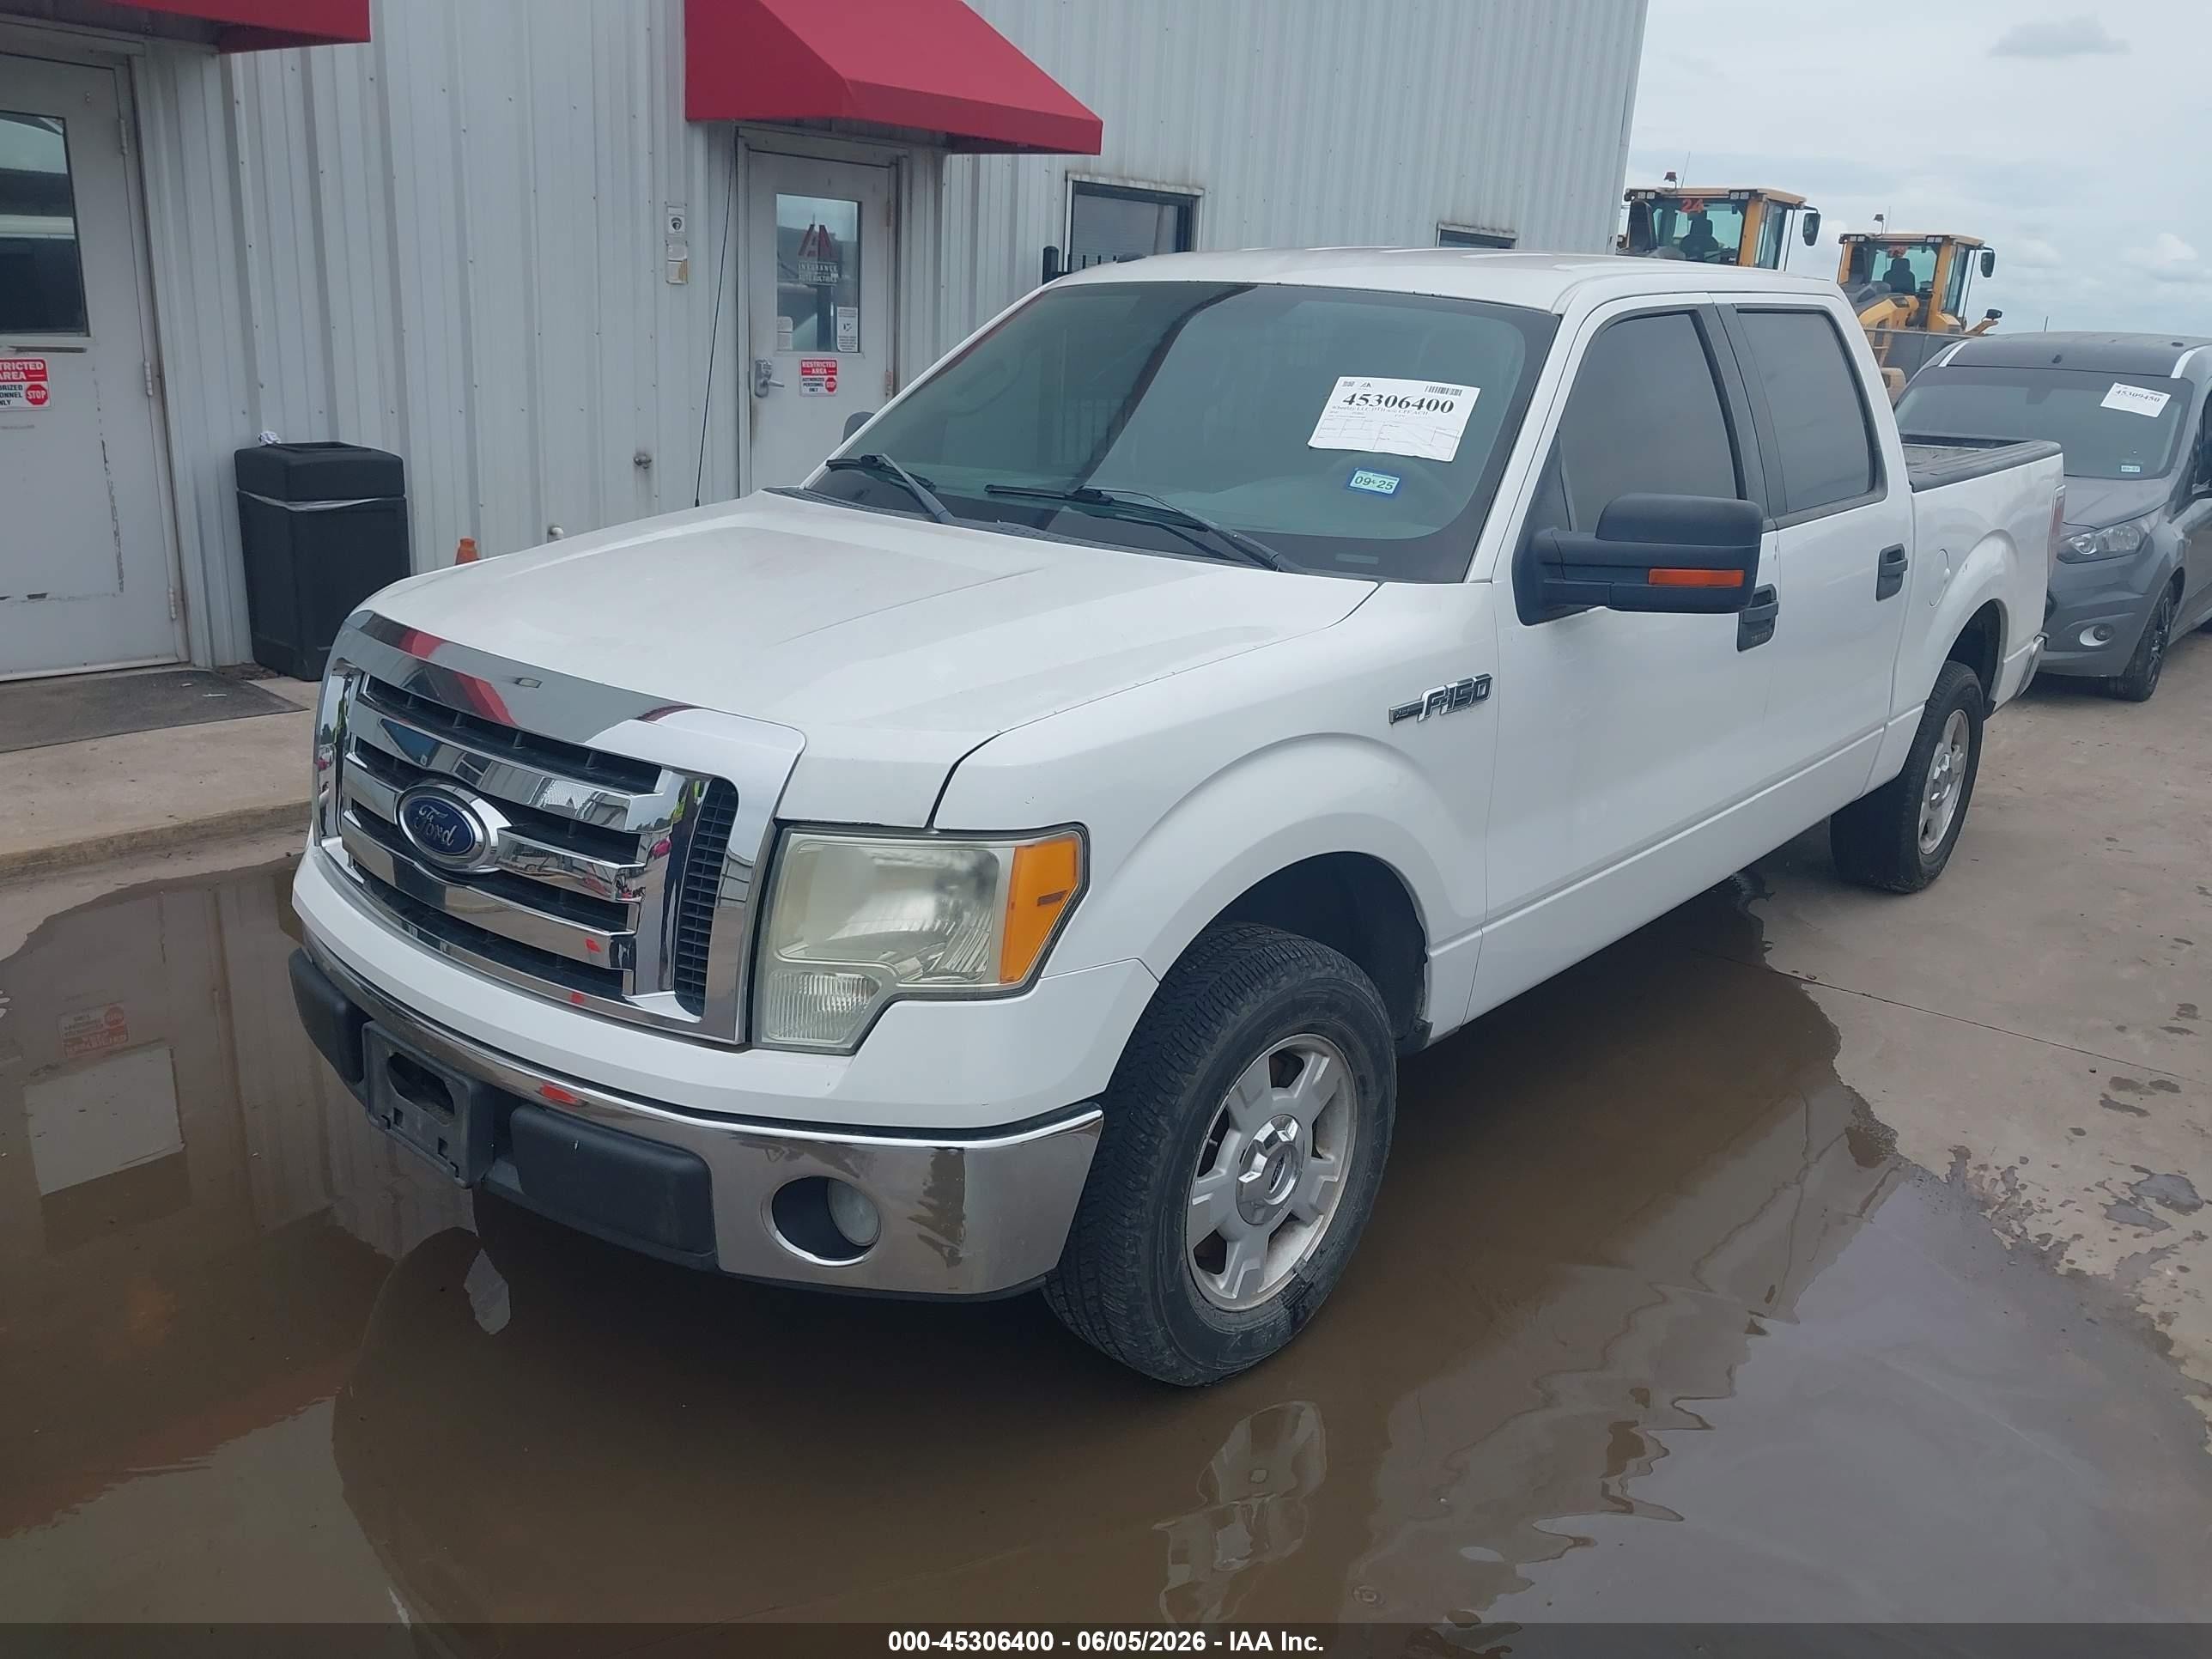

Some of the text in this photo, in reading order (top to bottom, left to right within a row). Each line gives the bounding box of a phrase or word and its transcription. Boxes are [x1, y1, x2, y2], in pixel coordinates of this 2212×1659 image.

[27, 390, 46, 398] STOP
[1342, 392, 1455, 414] 45306400
[414, 804, 459, 847] Ford
